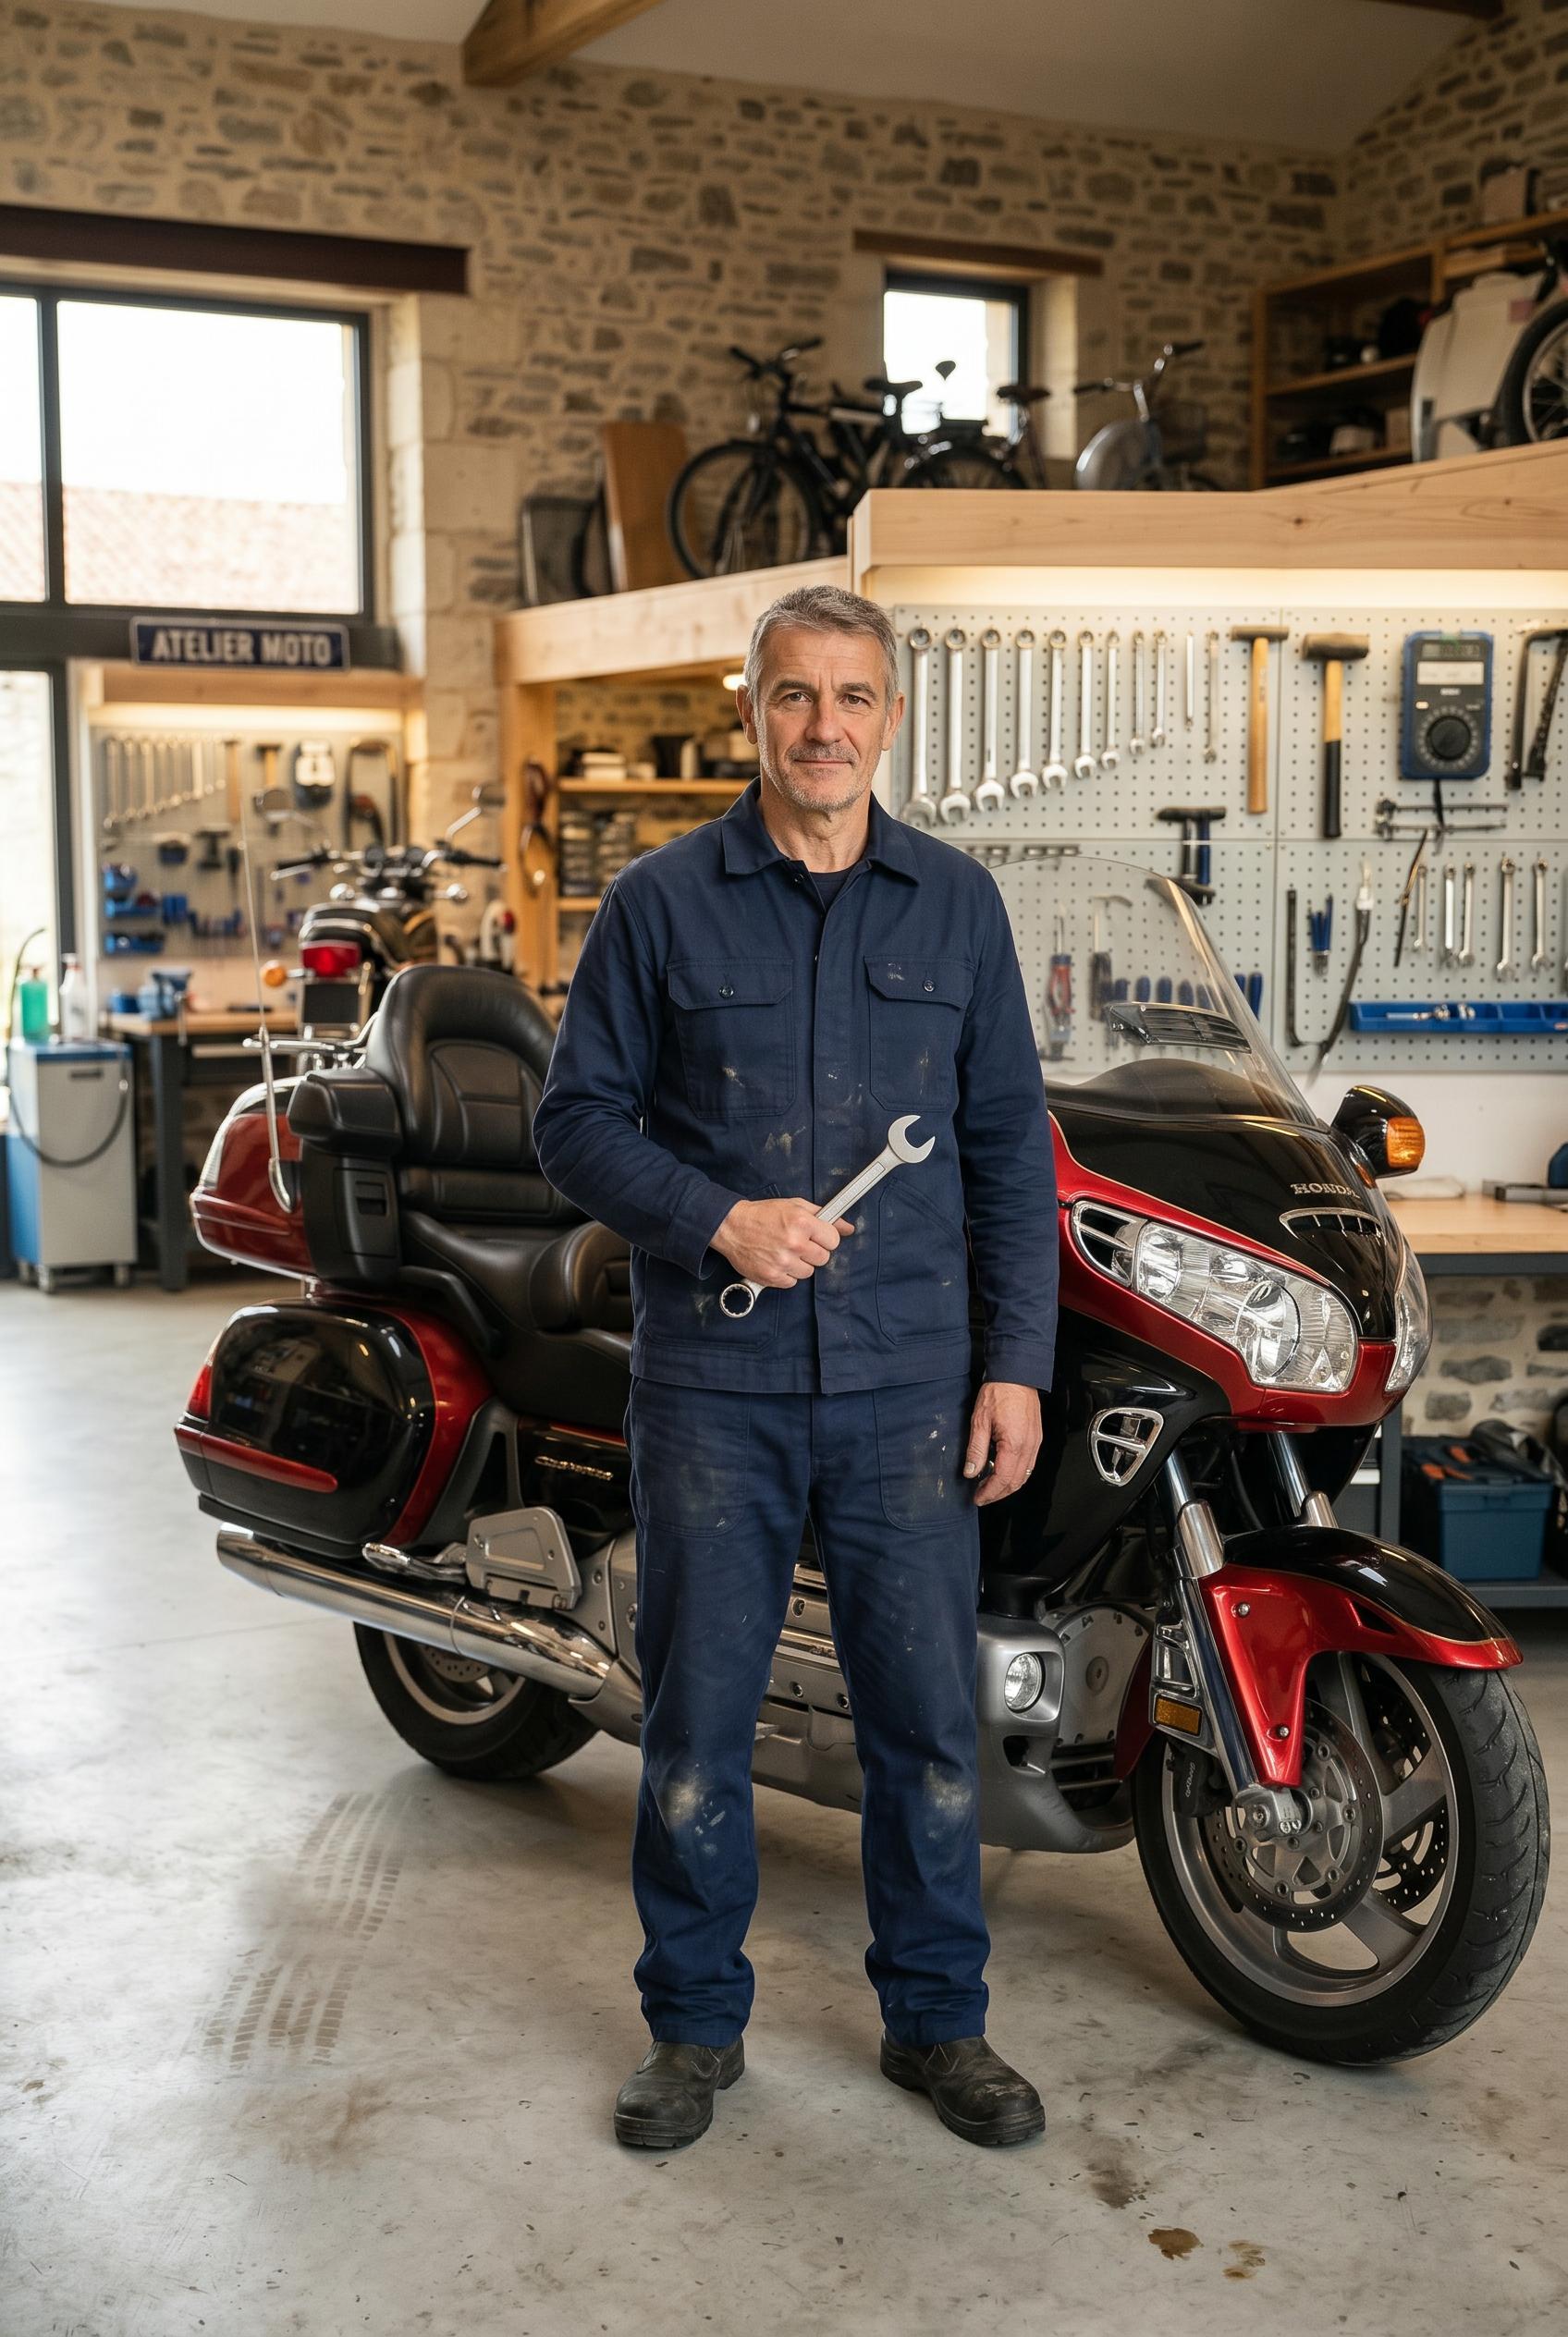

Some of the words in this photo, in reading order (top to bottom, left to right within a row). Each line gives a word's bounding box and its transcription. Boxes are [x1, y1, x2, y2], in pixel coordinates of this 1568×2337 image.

[152, 629, 255, 664] ATELIER
[260, 632, 333, 667] MOTO
[1290, 1182, 1361, 1199] HONDA
